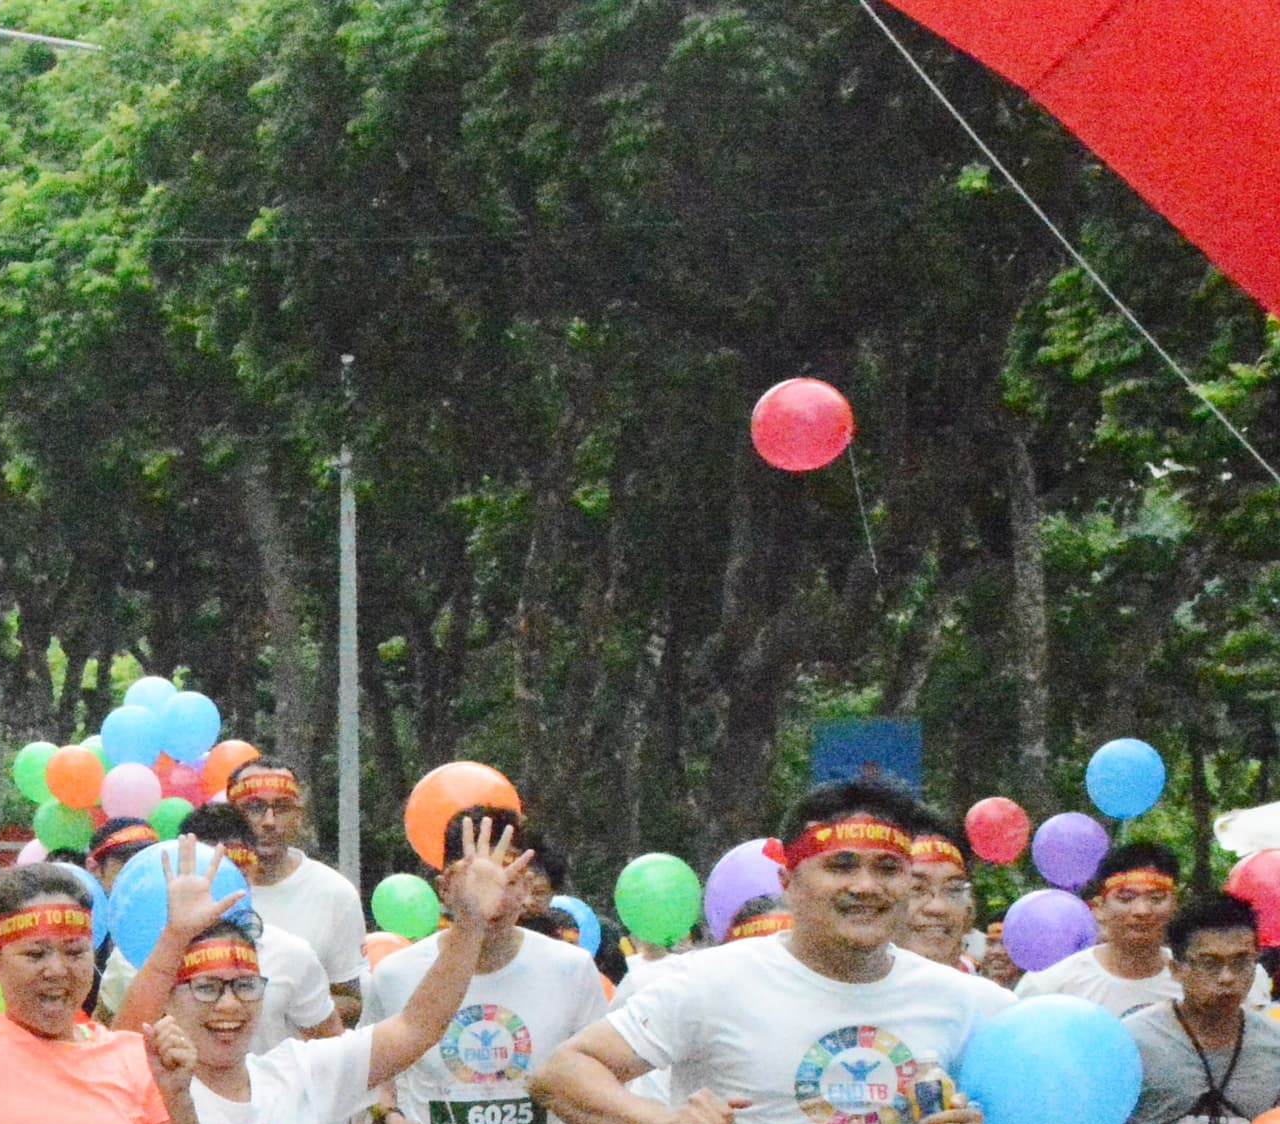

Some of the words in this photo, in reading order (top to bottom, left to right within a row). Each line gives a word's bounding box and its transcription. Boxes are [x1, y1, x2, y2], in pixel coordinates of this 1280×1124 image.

[836, 824, 890, 840] VICTORY
[46, 909, 63, 925] TO
[828, 1083, 865, 1100] END
[867, 1083, 888, 1100] TB
